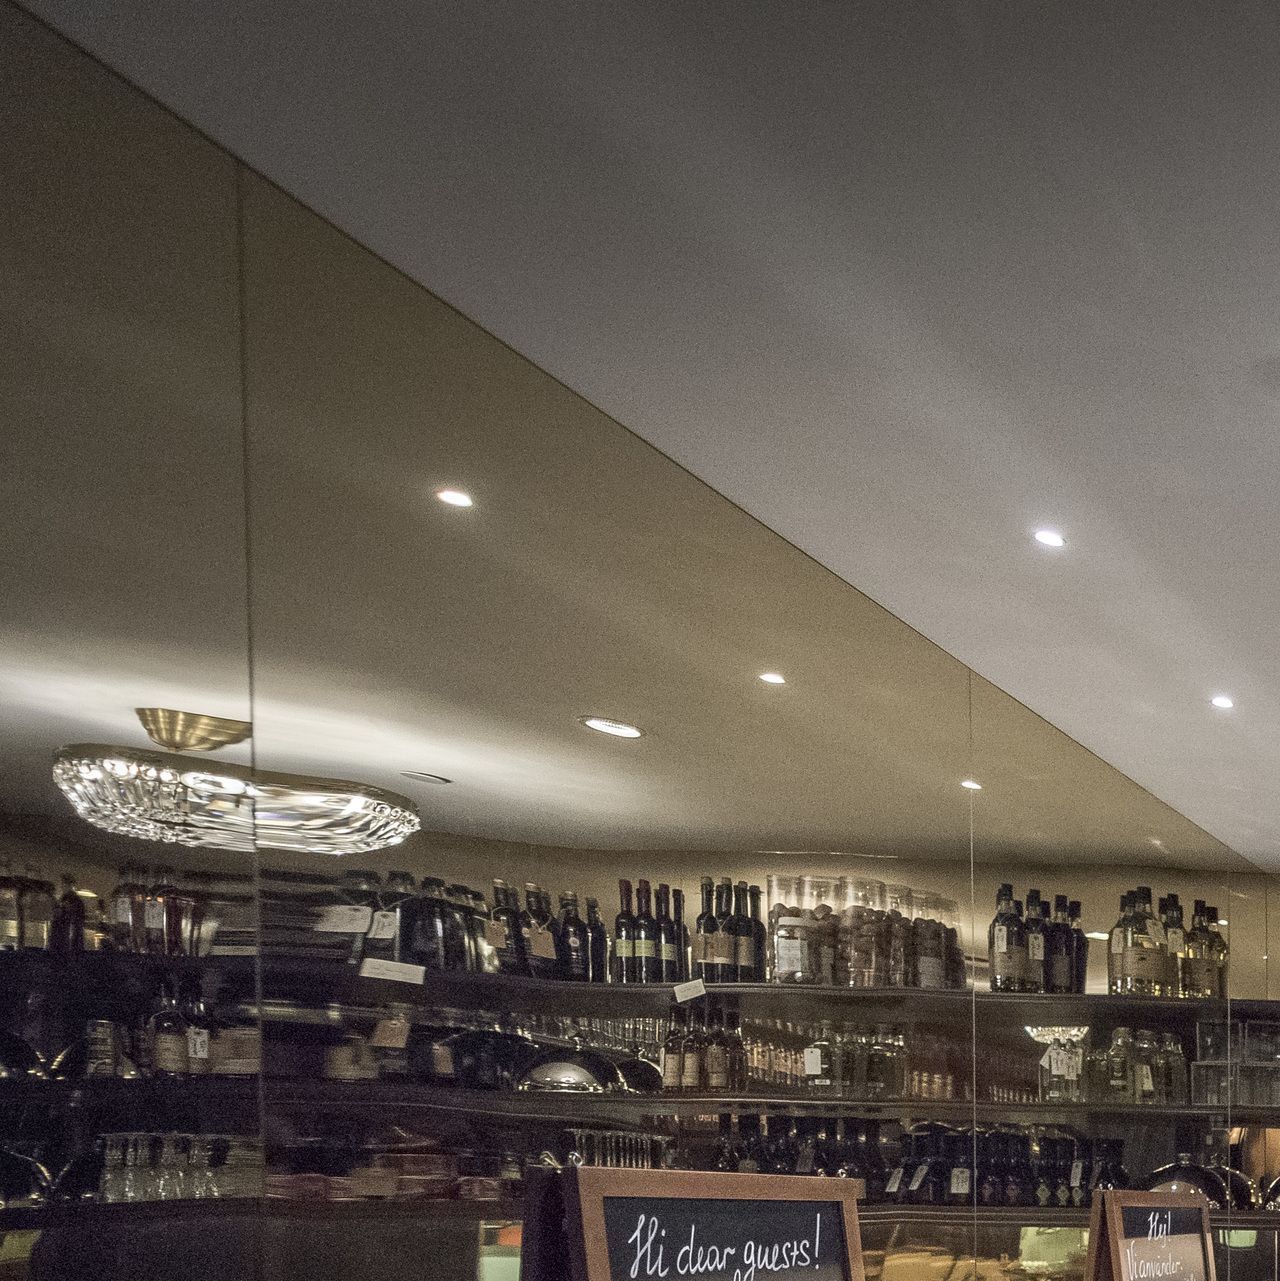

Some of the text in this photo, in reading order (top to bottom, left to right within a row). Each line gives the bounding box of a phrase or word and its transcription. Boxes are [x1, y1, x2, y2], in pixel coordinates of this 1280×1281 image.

[628, 1214, 669, 1278] Hi
[677, 1224, 735, 1274] dear
[1148, 1211, 1171, 1248] Hej!
